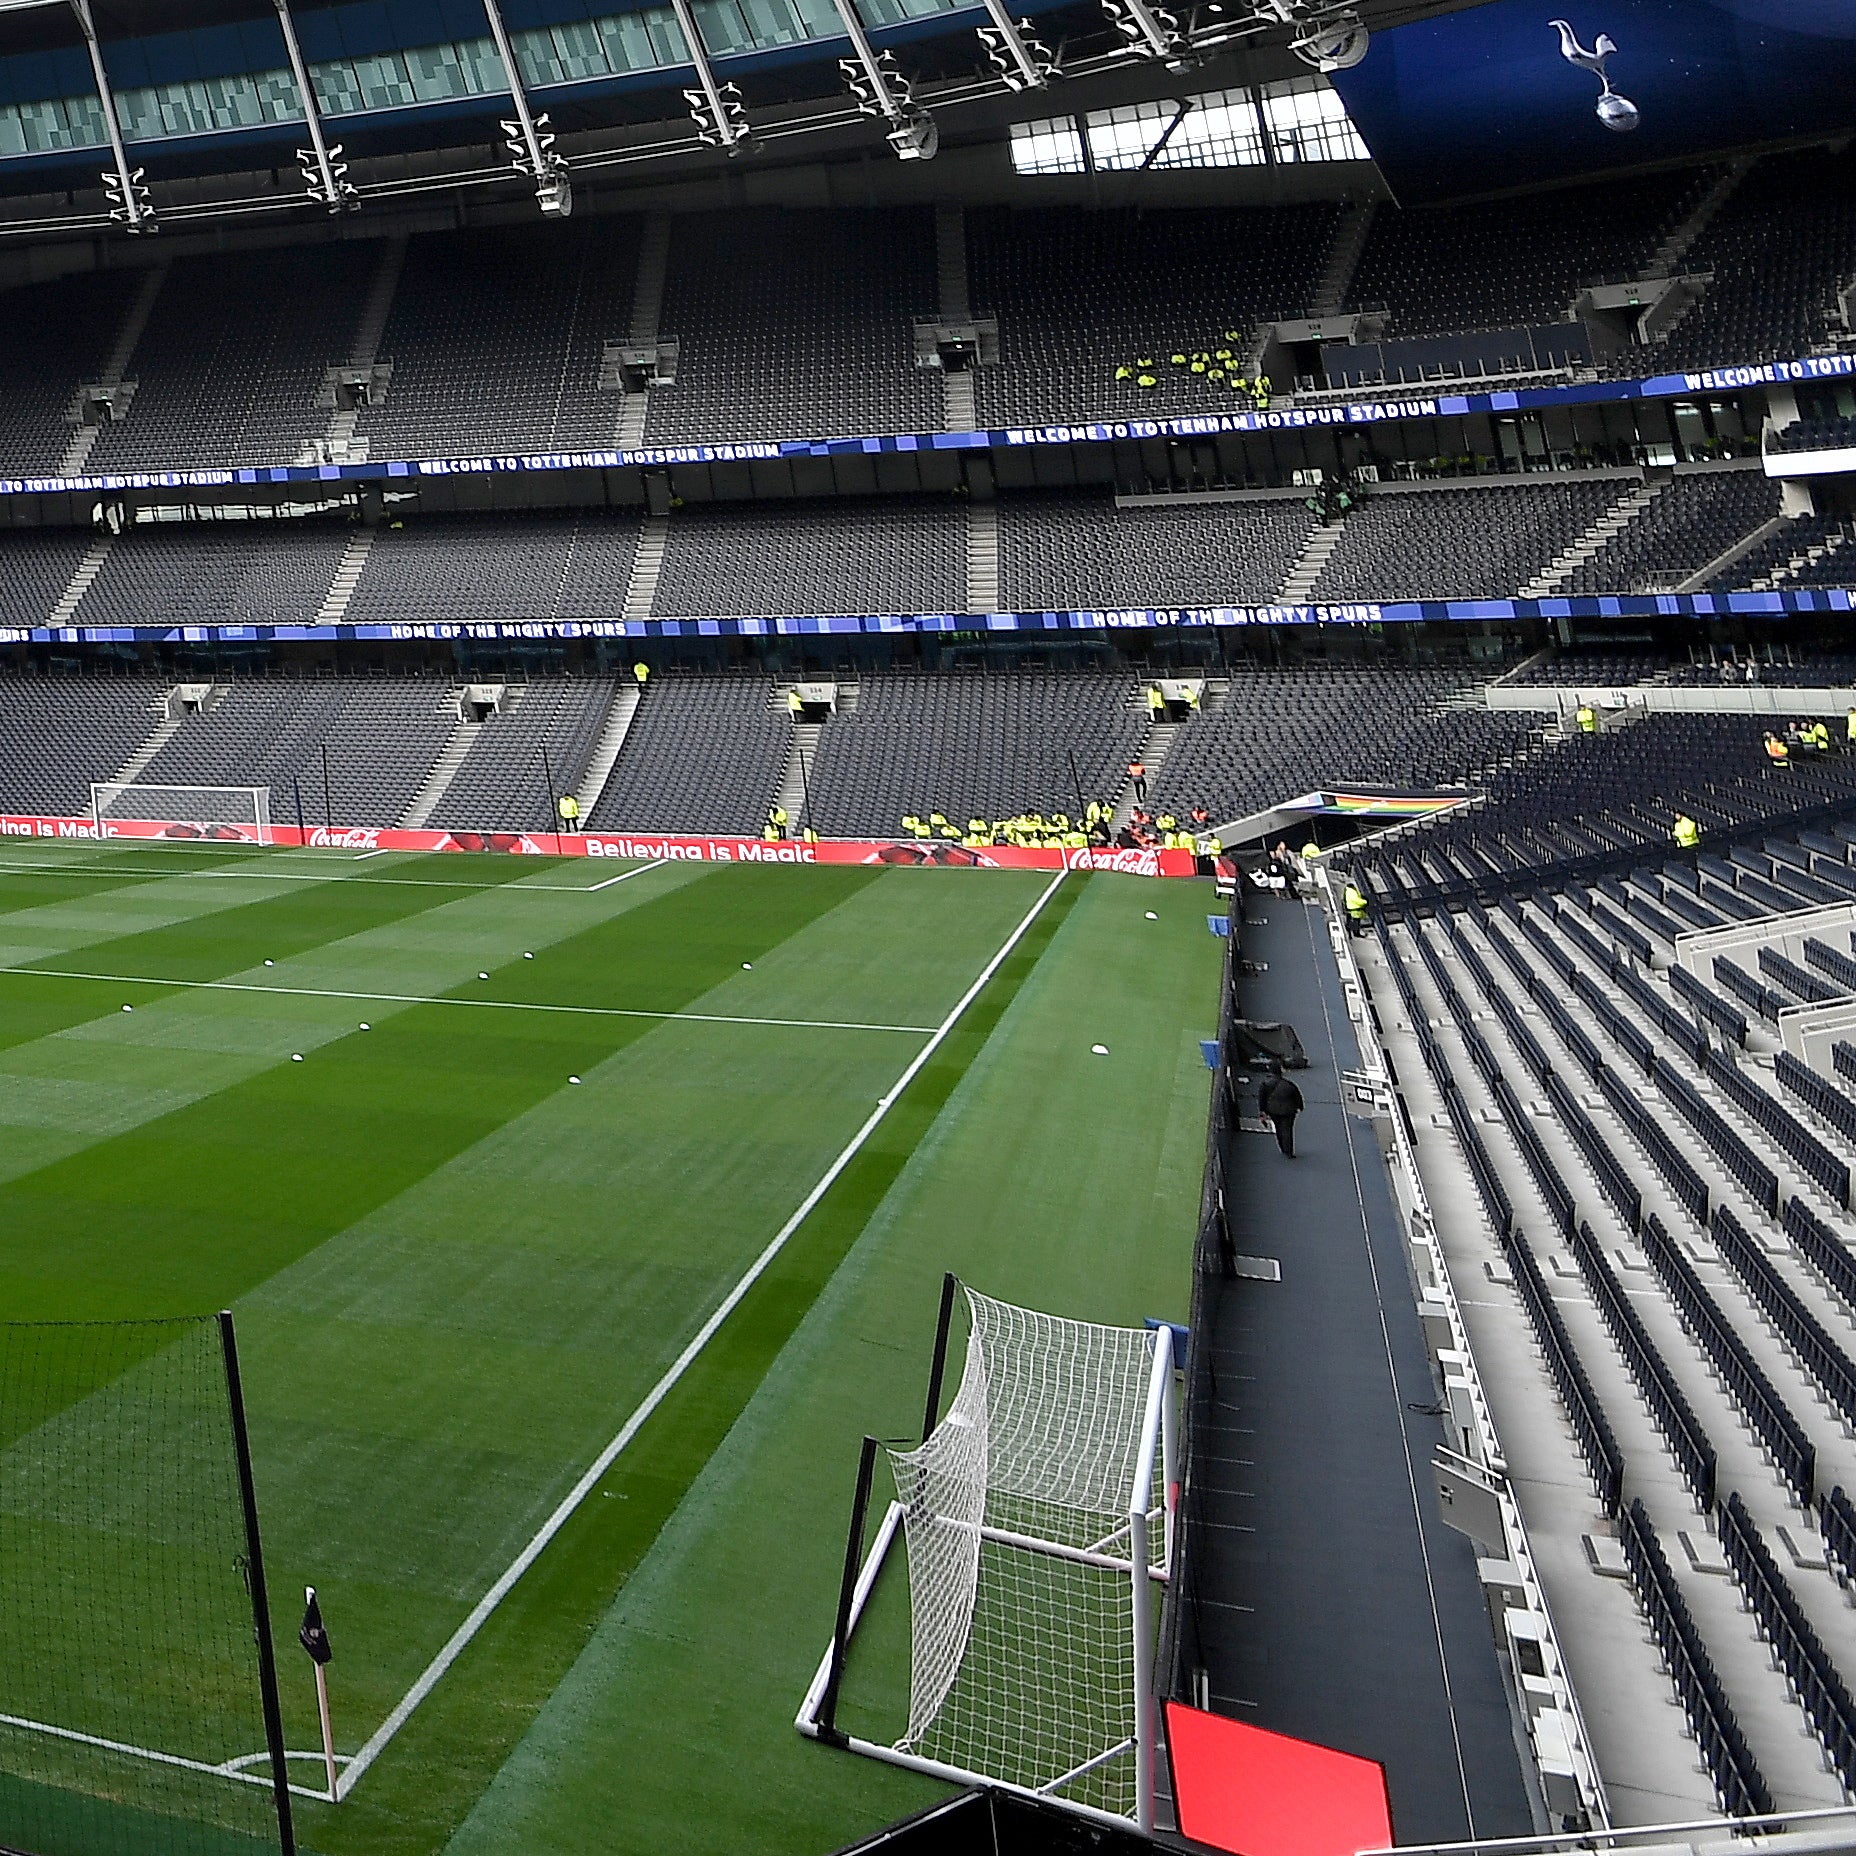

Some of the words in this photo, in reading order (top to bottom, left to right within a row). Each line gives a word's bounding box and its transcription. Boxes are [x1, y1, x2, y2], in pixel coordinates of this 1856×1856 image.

[1684, 364, 1774, 390] WELCOME
[1778, 361, 1803, 380] TO
[1806, 354, 1856, 376] TOTT
[1006, 425, 1097, 444] WELCOME
[1104, 423, 1128, 439] TO
[1132, 415, 1249, 437] TOTTENHAM
[1255, 408, 1345, 429] HOTSPUR
[1350, 400, 1436, 422] STADIUM
[419, 459, 493, 475] WELCOME
[496, 457, 517, 470] TO
[520, 452, 621, 469] TOTTENHAM
[622, 447, 699, 464] HOTSPUR
[703, 444, 780, 461] STADIUM
[6, 480, 23, 494] TO
[24, 477, 103, 493] TOTTENHAM
[105, 473, 168, 490] HOTSPUR
[171, 471, 232, 486] STADIUM
[1092, 611, 1147, 626] HOME
[1155, 610, 1181, 625] OF
[1186, 609, 1224, 625] THE
[1232, 606, 1309, 623] MIGHTY
[1315, 604, 1381, 622] SPURS
[390, 625, 436, 639] HOME
[440, 625, 461, 639] OF
[465, 624, 497, 638] THE
[502, 623, 565, 638] MIGHTY
[570, 622, 626, 637] SPURS
[36, 819, 54, 837] is
[585, 839, 703, 860] Believing
[709, 842, 731, 861] is
[737, 843, 815, 863] Magic
